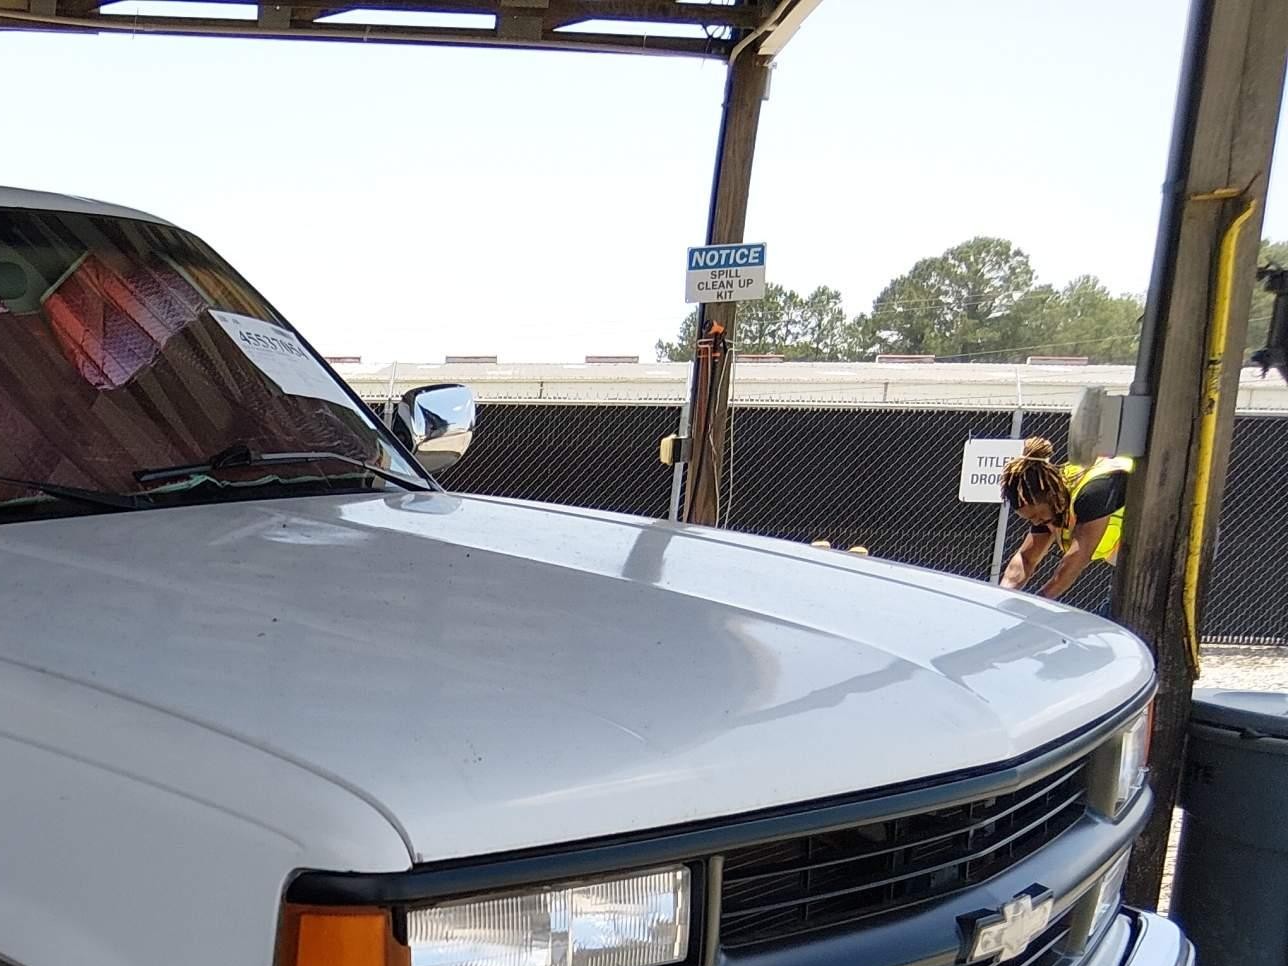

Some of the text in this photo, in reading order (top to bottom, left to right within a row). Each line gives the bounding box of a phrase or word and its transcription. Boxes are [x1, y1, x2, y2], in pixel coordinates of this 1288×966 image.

[691, 247, 762, 268] NOTICE
[710, 268, 741, 280] SPILL
[697, 278, 754, 291] CLEAN UP
[716, 290, 734, 300] KIT
[976, 456, 1015, 468] TITLE
